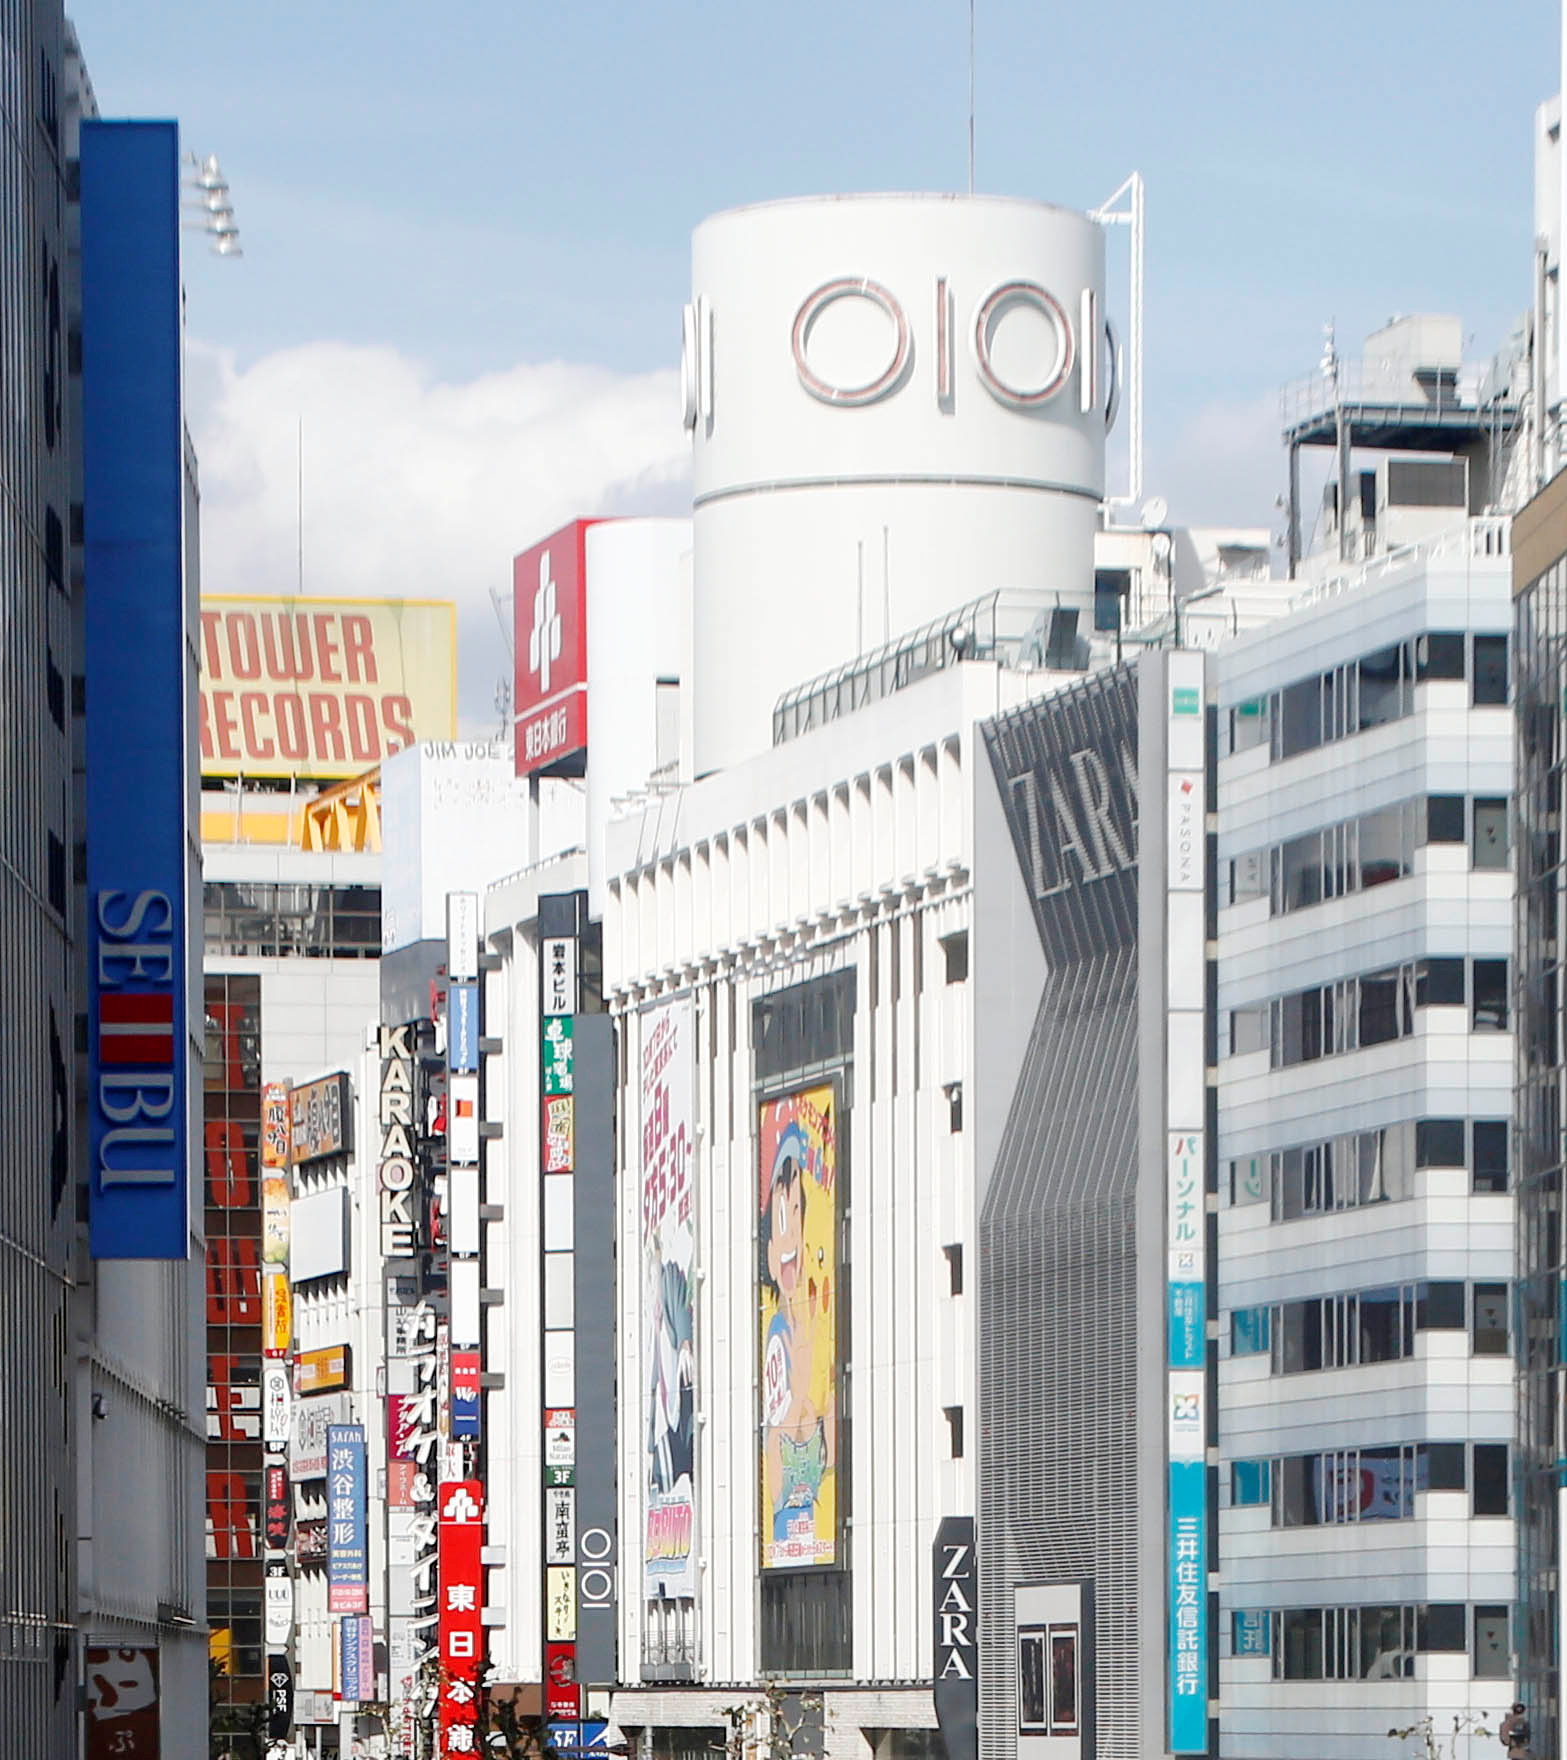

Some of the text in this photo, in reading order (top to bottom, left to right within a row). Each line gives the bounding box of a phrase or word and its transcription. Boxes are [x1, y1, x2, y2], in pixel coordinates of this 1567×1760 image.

[551, 943, 567, 1011] 岩本ビル
[96, 887, 175, 1195] SEIBU
[380, 1026, 416, 1258] KARAOKE
[1175, 1136, 1197, 1241] パーソナル
[332, 1448, 355, 1545] 渋谷整形
[553, 1470, 571, 1485] 3F
[938, 1543, 973, 1681] ZARA
[1175, 1517, 1202, 1697] 三井住友信託銀行
